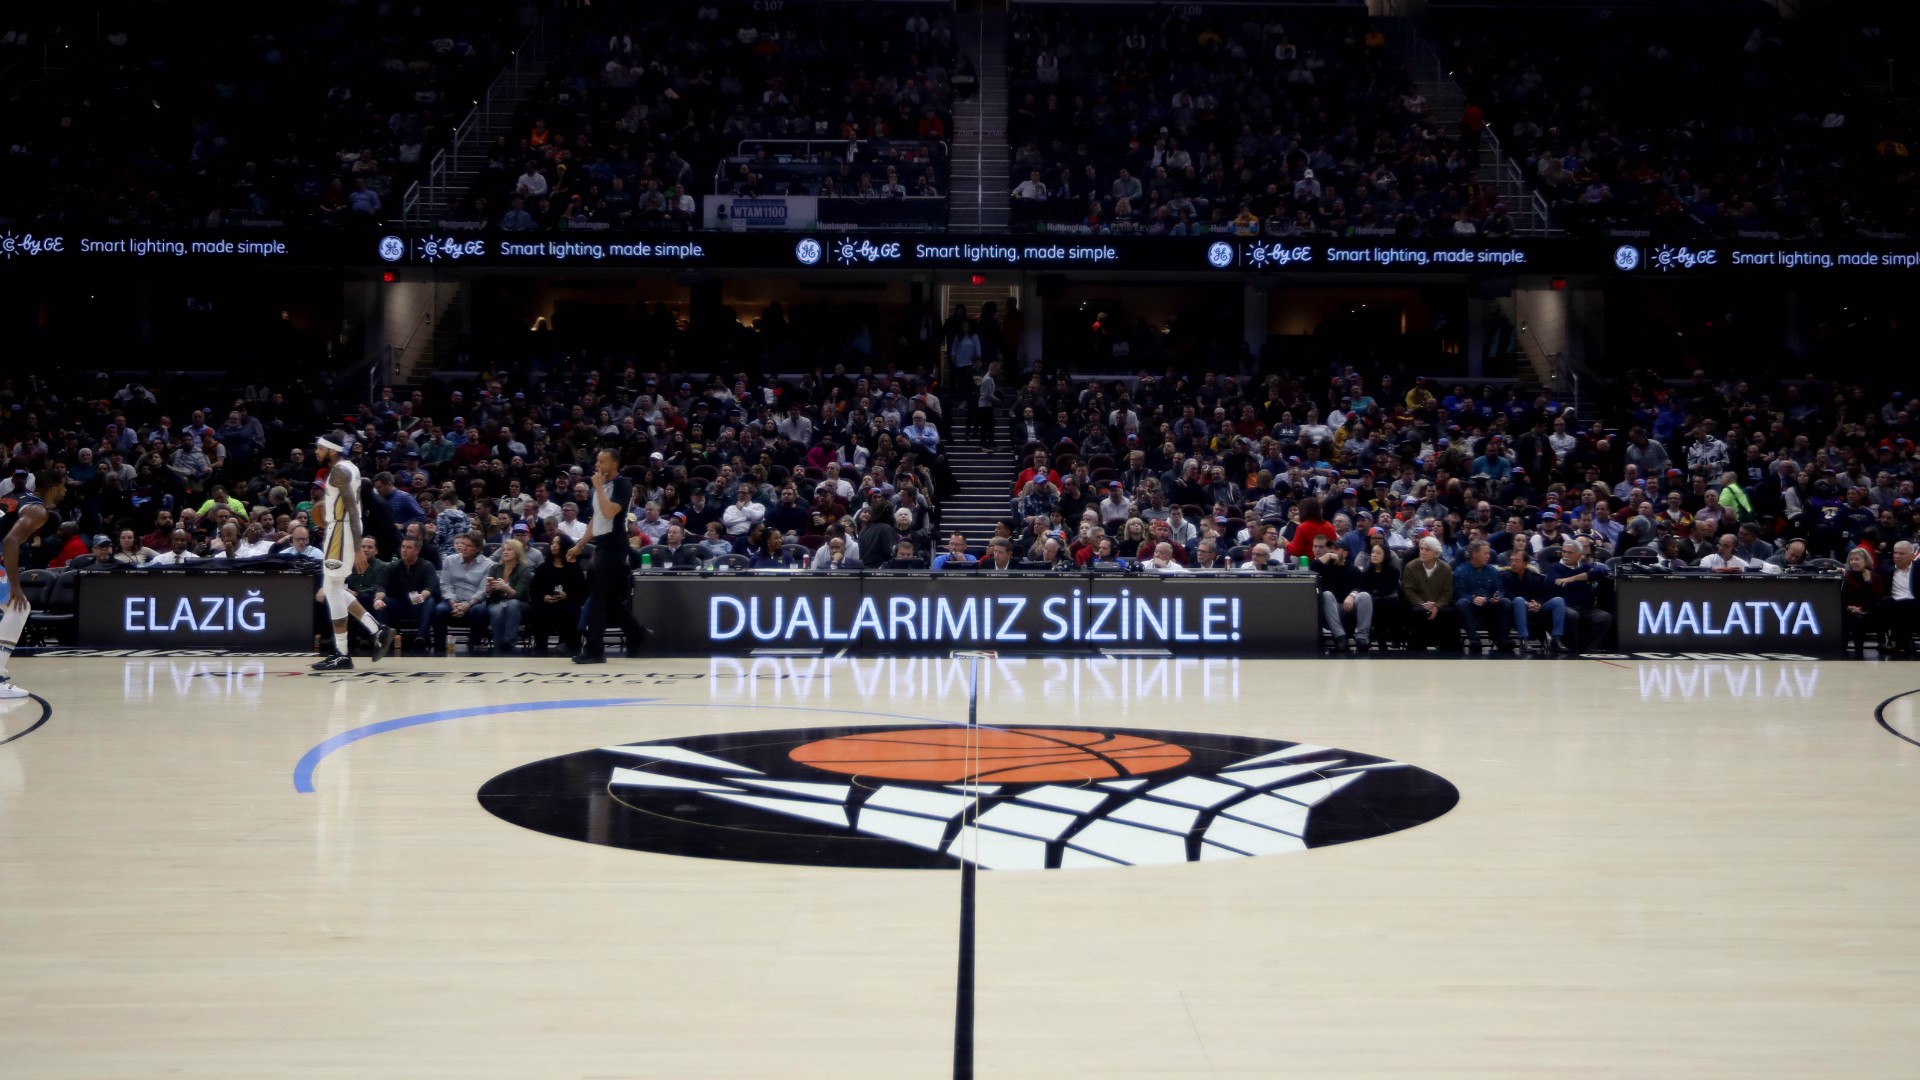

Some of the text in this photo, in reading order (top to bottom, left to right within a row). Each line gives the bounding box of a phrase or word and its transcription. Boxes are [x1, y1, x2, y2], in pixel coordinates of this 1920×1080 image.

[43, 236, 65, 252] GE
[81, 238, 289, 256] Smart lighting, made simple.
[464, 240, 485, 255] GE
[500, 241, 705, 259] Smart lighting, made simple.
[880, 242, 901, 258] GE
[916, 243, 1119, 262] Smart lighting, made simple.
[1291, 246, 1313, 261] GE
[1327, 247, 1527, 266] Smart lighting, made simple.
[1696, 249, 1718, 264] GE
[1732, 250, 1920, 269] Smart lighting, made simpl
[125, 589, 266, 632] ELAZIĞ
[709, 588, 1241, 642] DUALARIMIZ SİZİNLE!
[1637, 601, 1821, 635] MALATYA
